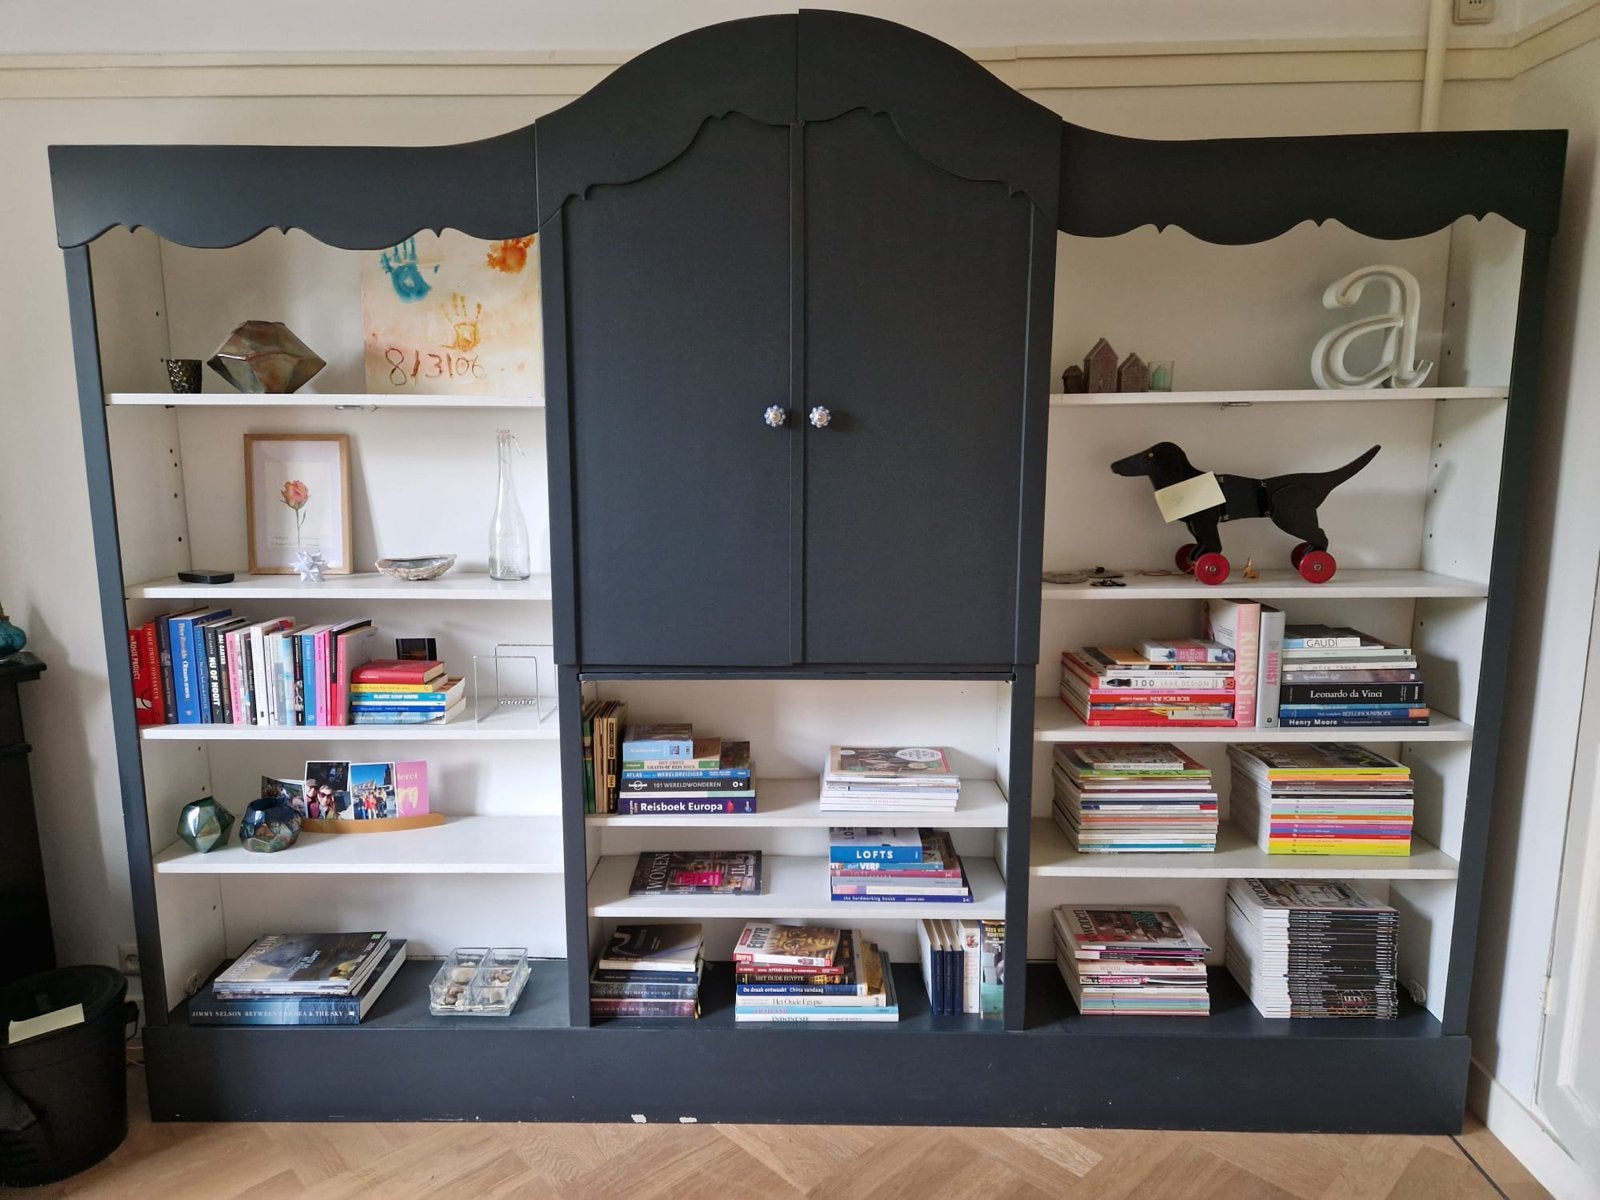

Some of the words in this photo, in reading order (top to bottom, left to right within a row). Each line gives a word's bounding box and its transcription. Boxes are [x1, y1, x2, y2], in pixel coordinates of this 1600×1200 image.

[1311, 264, 1434, 390] a
[208, 656, 218, 668] NU
[1238, 633, 1255, 696] KUNST
[210, 669, 218, 681] OF
[1266, 651, 1279, 687] KUNST
[1134, 679, 1155, 688] 100
[211, 682, 220, 706] NOOIT
[1310, 690, 1348, 698] Leonardo
[1349, 690, 1359, 698] da
[1362, 689, 1383, 698] Vinci
[640, 802, 685, 811] Reisboek
[688, 802, 723, 812] Europa
[856, 850, 893, 859] LOFTS
[646, 853, 671, 891] WONEN
[802, 998, 824, 1007] Egypte
